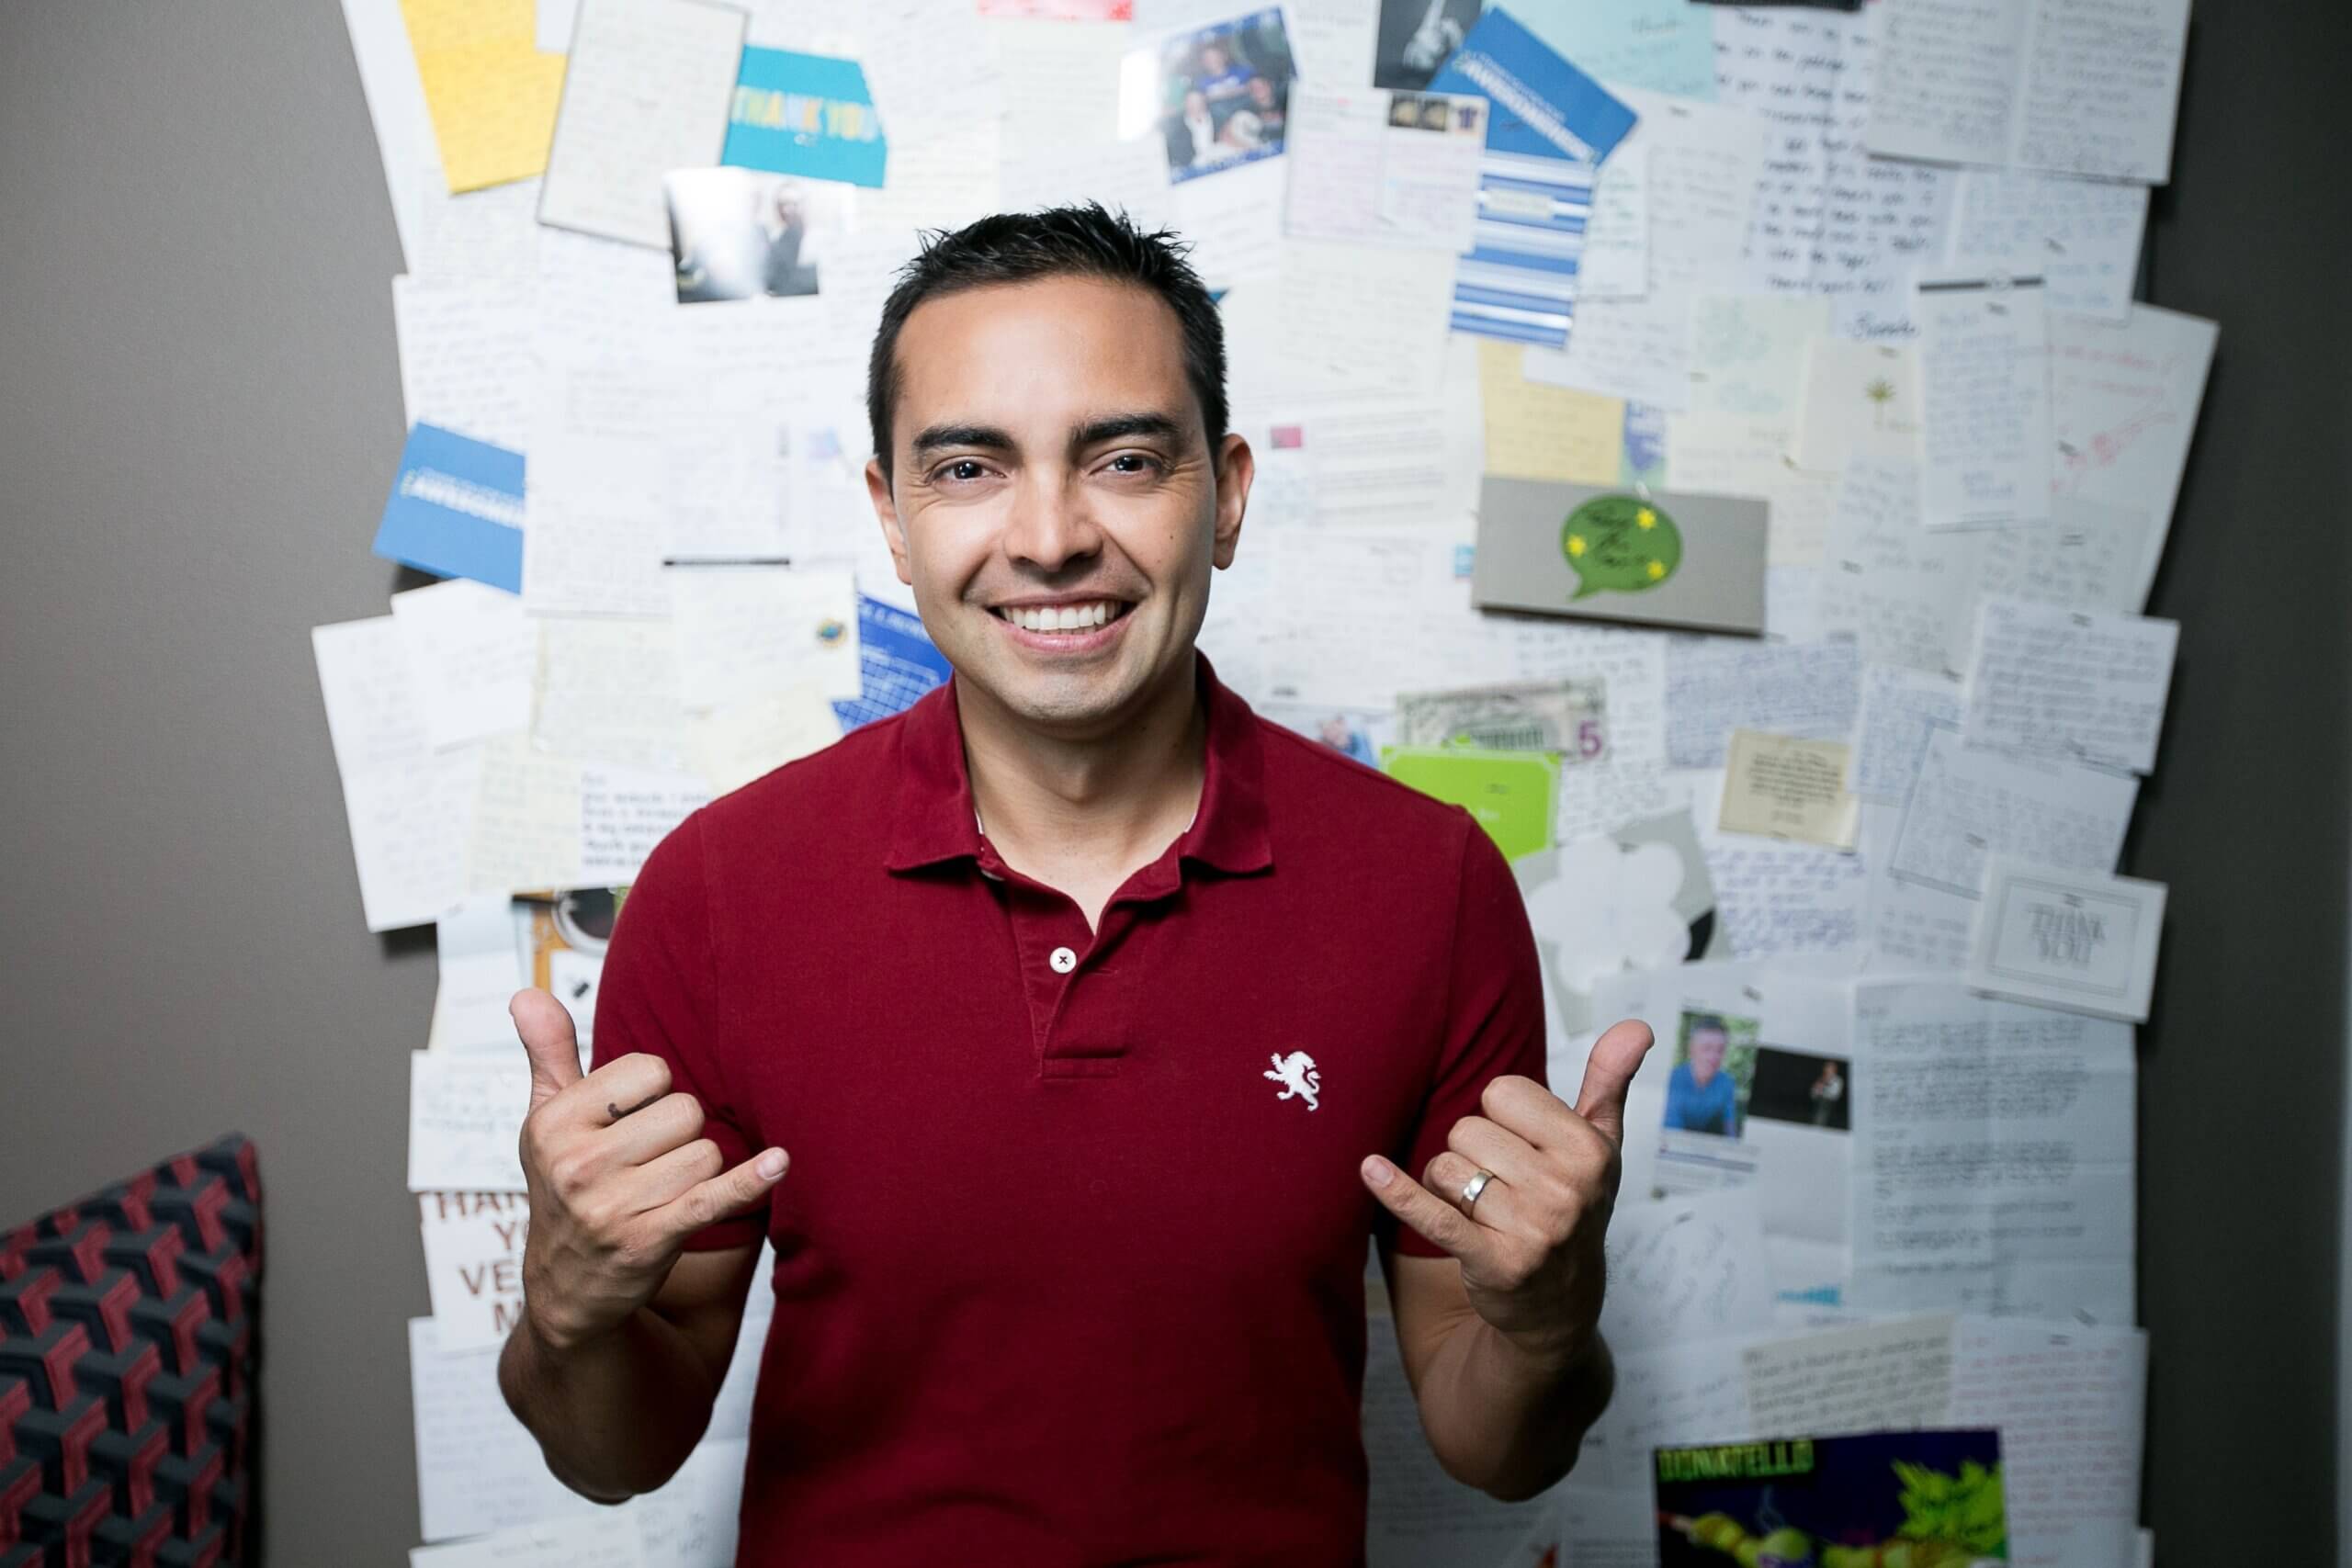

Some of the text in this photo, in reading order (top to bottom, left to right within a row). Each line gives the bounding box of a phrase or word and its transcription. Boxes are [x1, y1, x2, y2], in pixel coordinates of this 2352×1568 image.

[1578, 718, 1602, 757] 5
[2037, 935, 2091, 969] YOU
[459, 1259, 518, 1295] VE
[1659, 1437, 1815, 1482] DONATELLO
